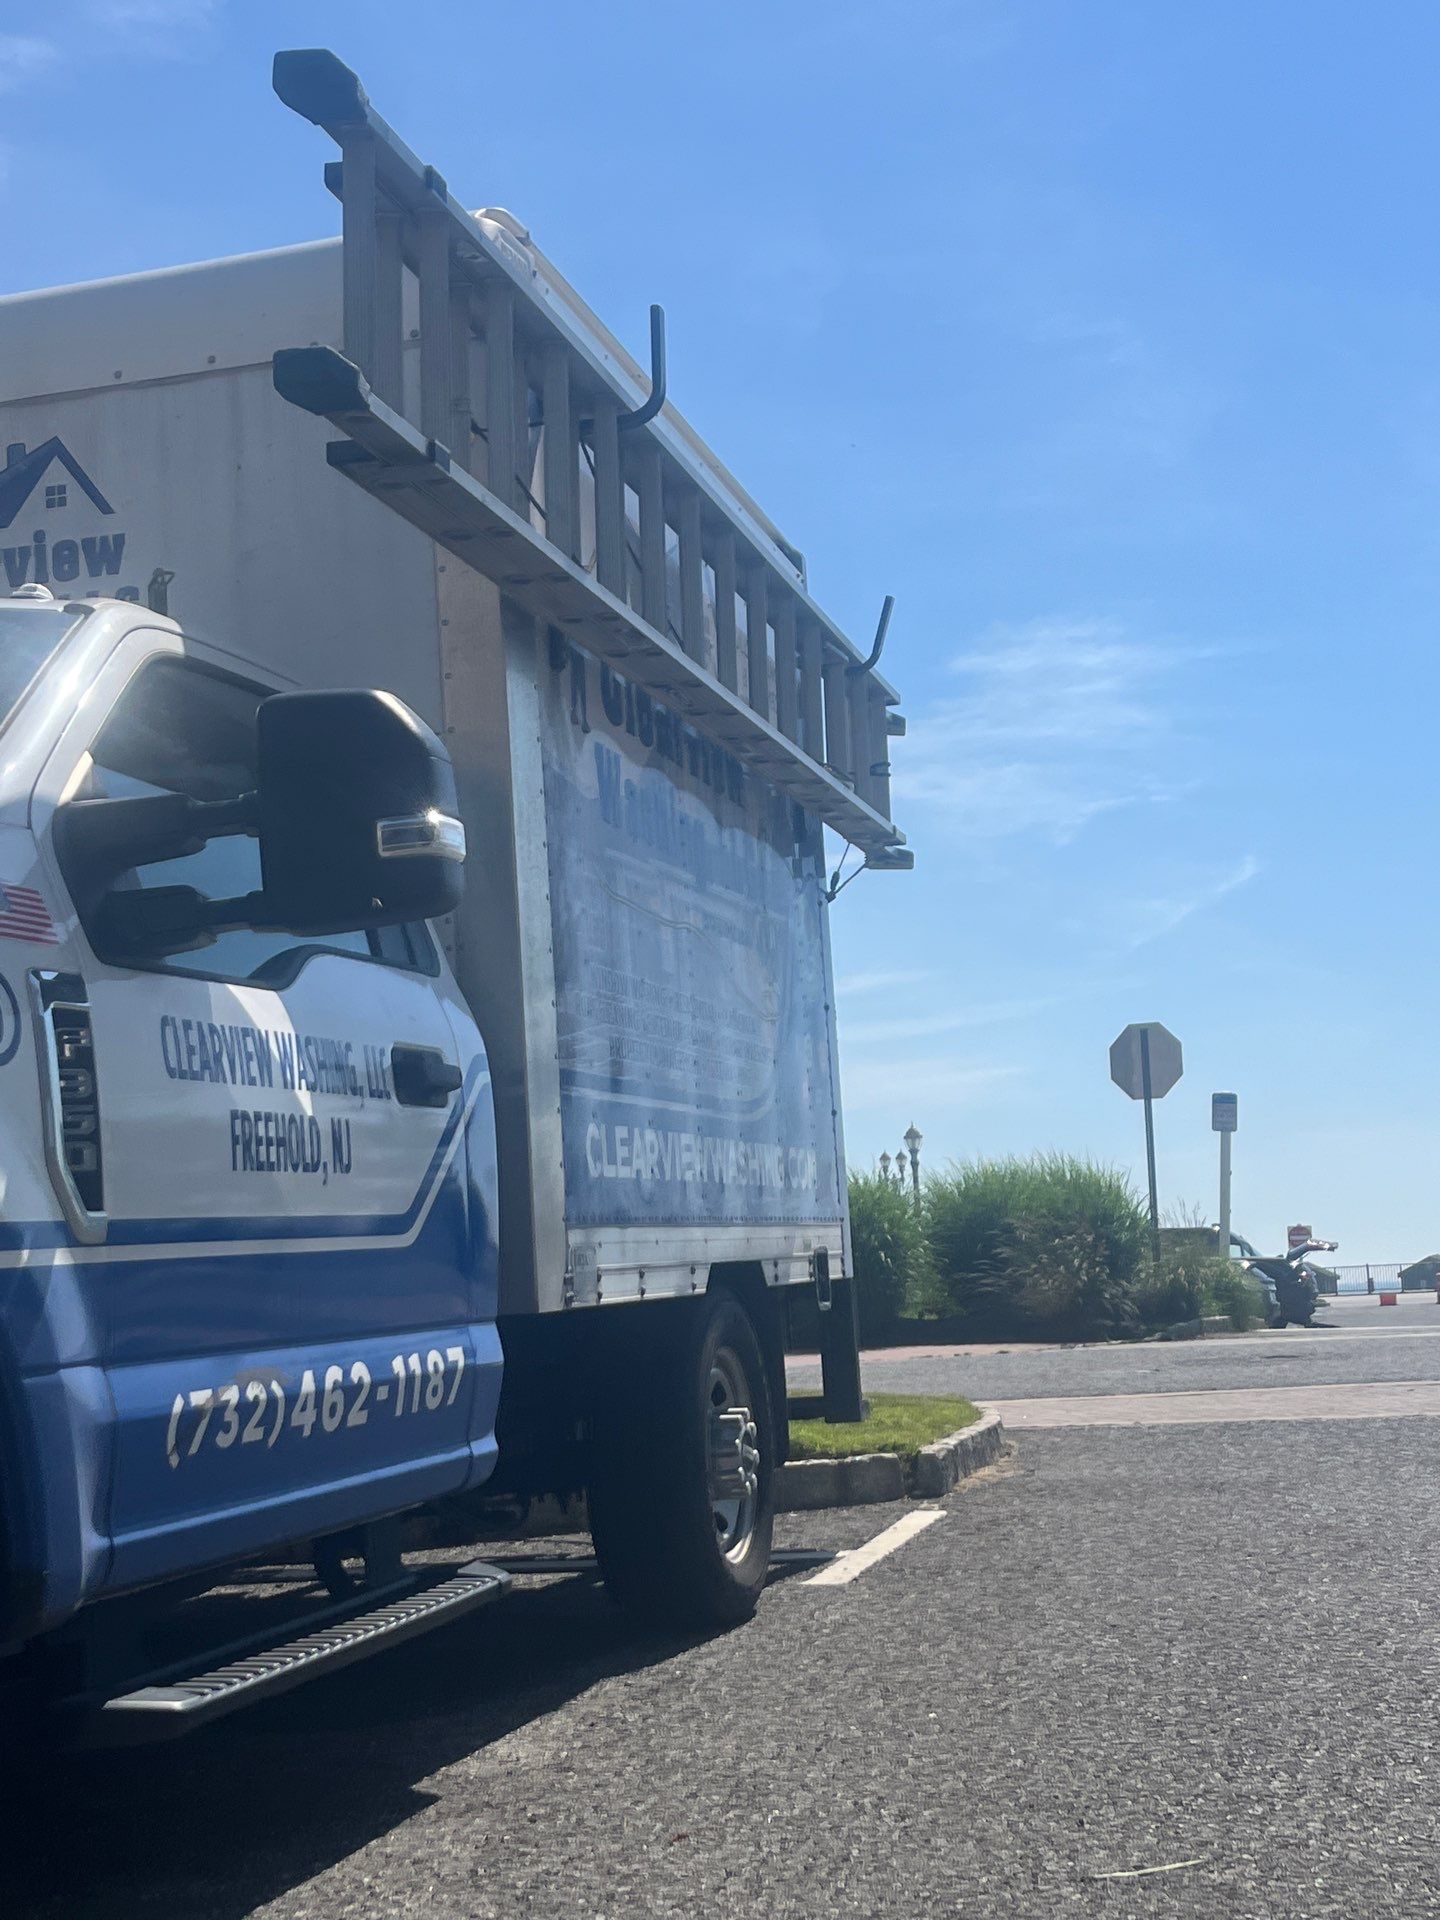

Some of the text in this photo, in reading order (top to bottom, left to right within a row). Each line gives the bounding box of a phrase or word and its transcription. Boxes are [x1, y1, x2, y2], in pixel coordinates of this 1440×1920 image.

[160, 1015, 274, 1088] CLEARVIEW
[230, 1108, 353, 1186] FREEHOLD, NJ
